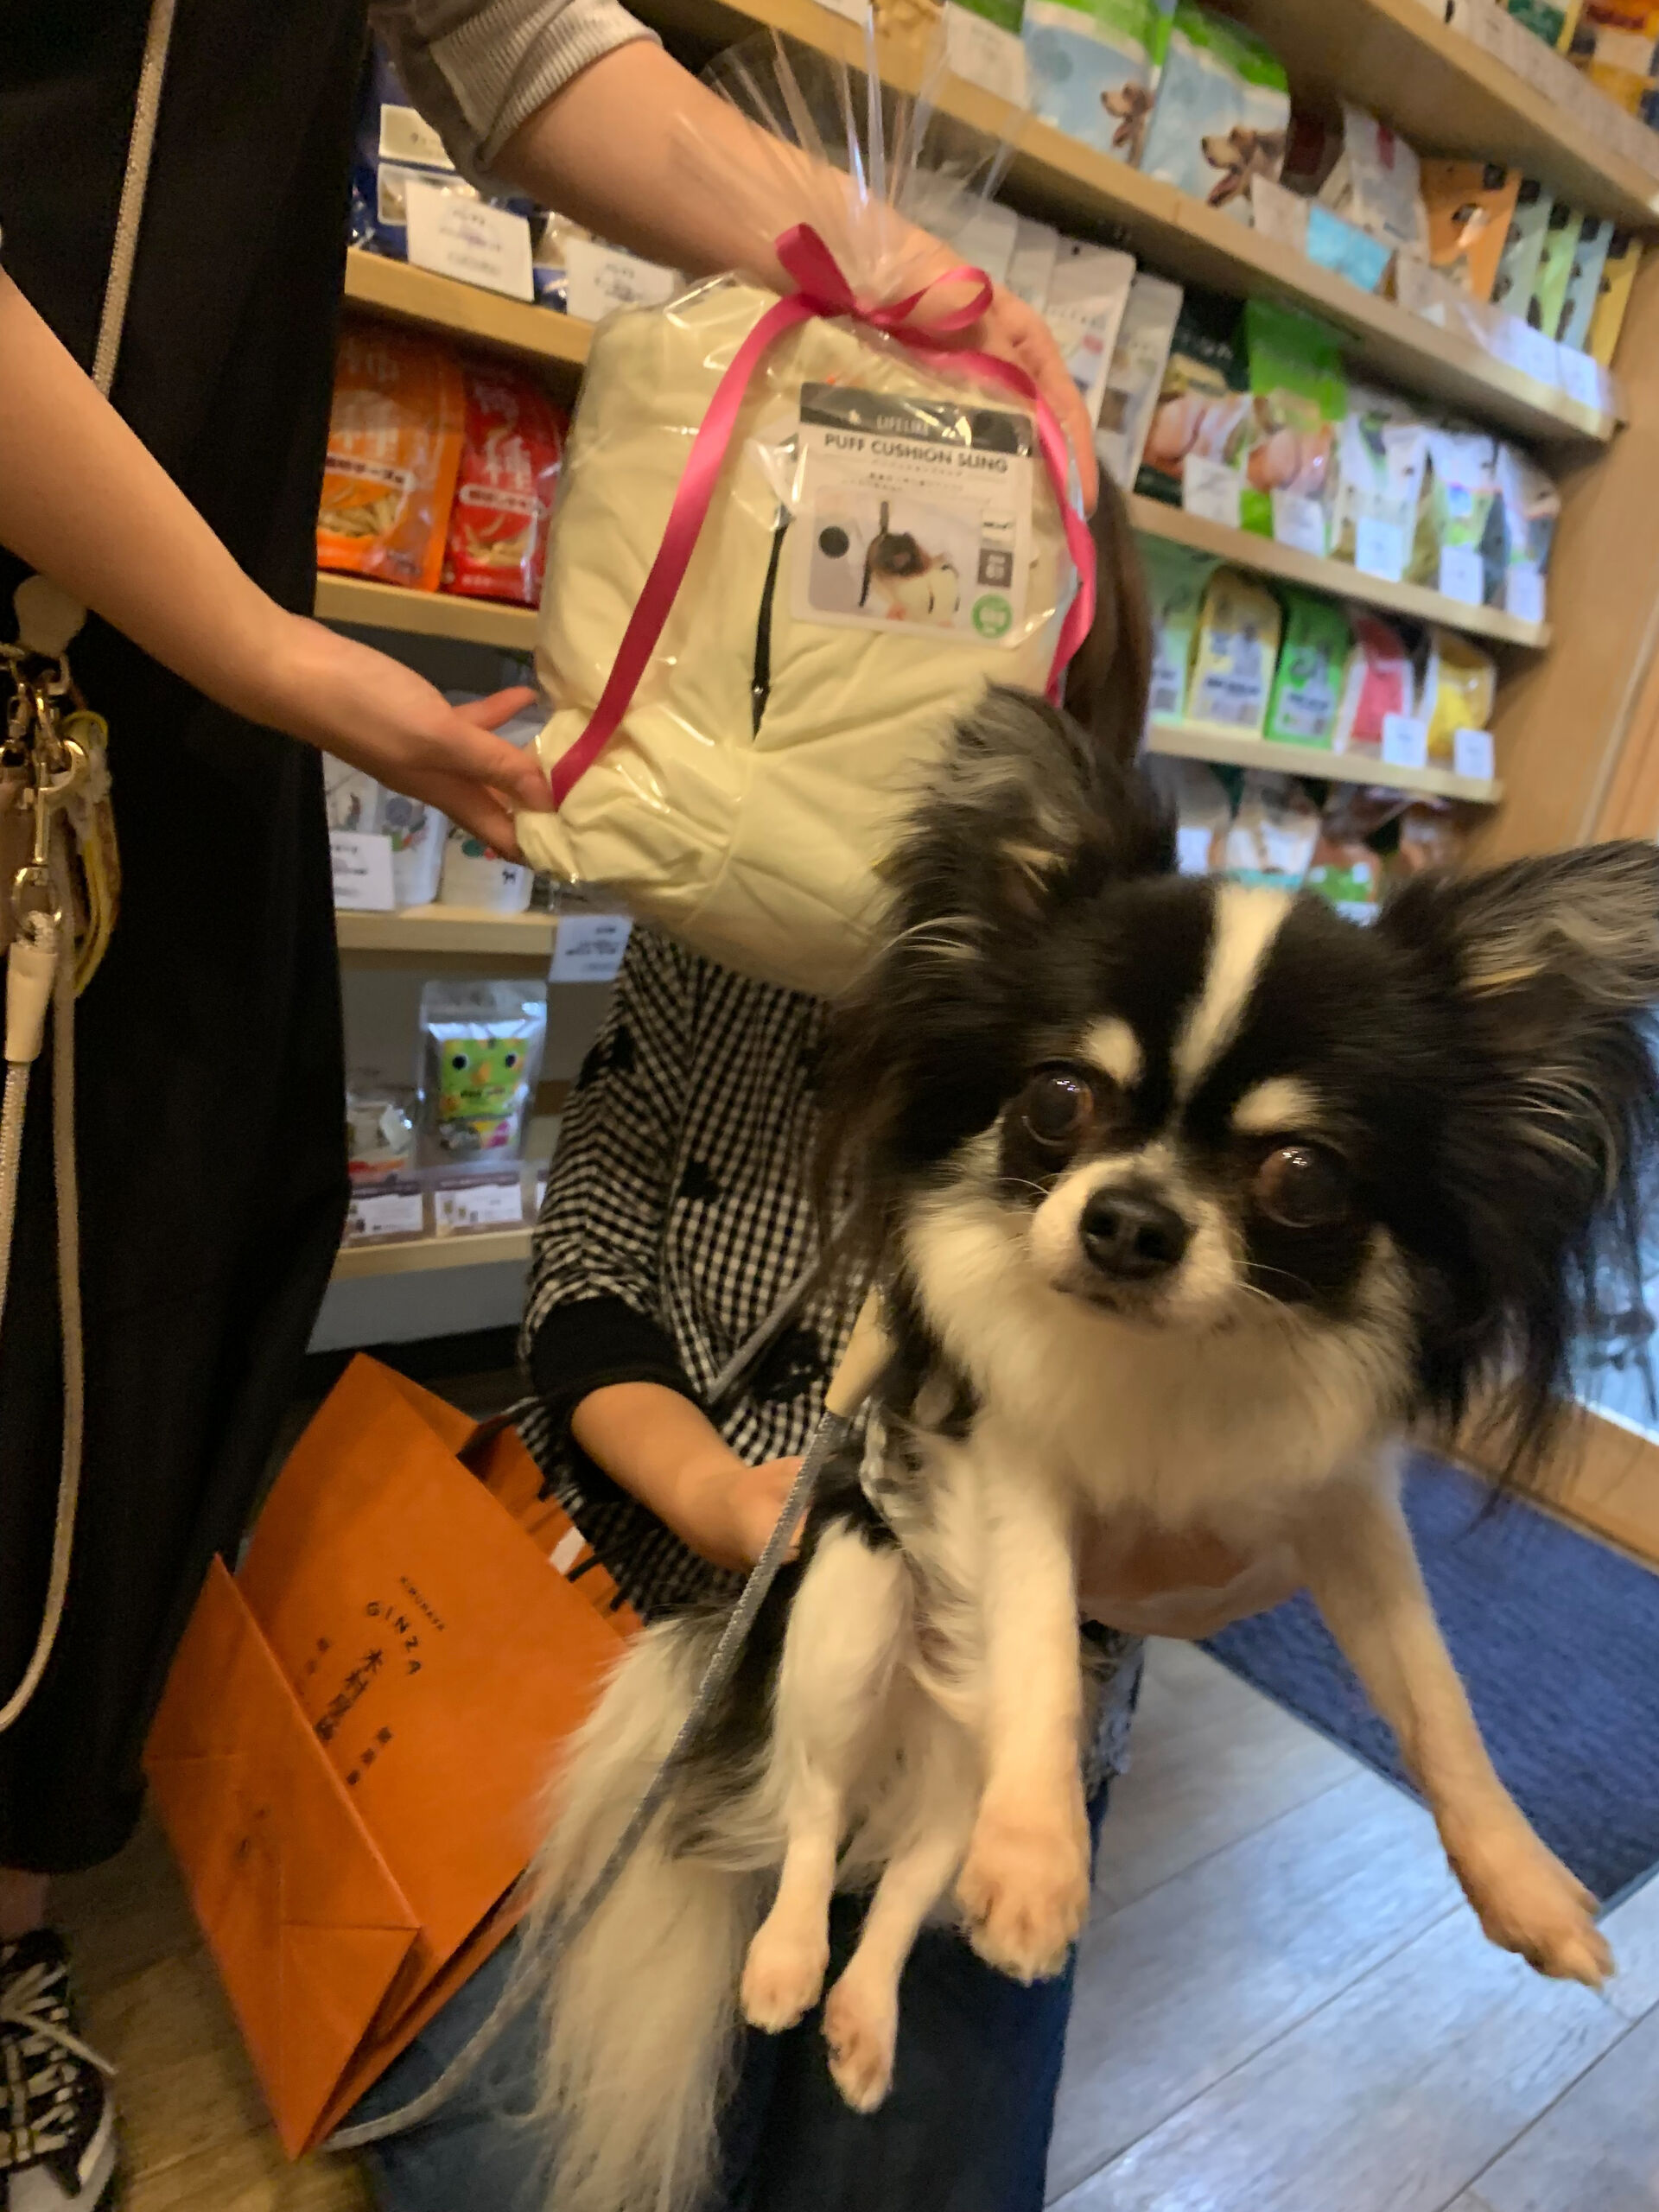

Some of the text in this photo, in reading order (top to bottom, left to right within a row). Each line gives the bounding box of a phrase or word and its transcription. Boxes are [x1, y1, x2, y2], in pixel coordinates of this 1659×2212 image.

[824, 433, 865, 452] PUFF
[871, 440, 952, 466] CUSHION
[958, 452, 1008, 474] SLING
